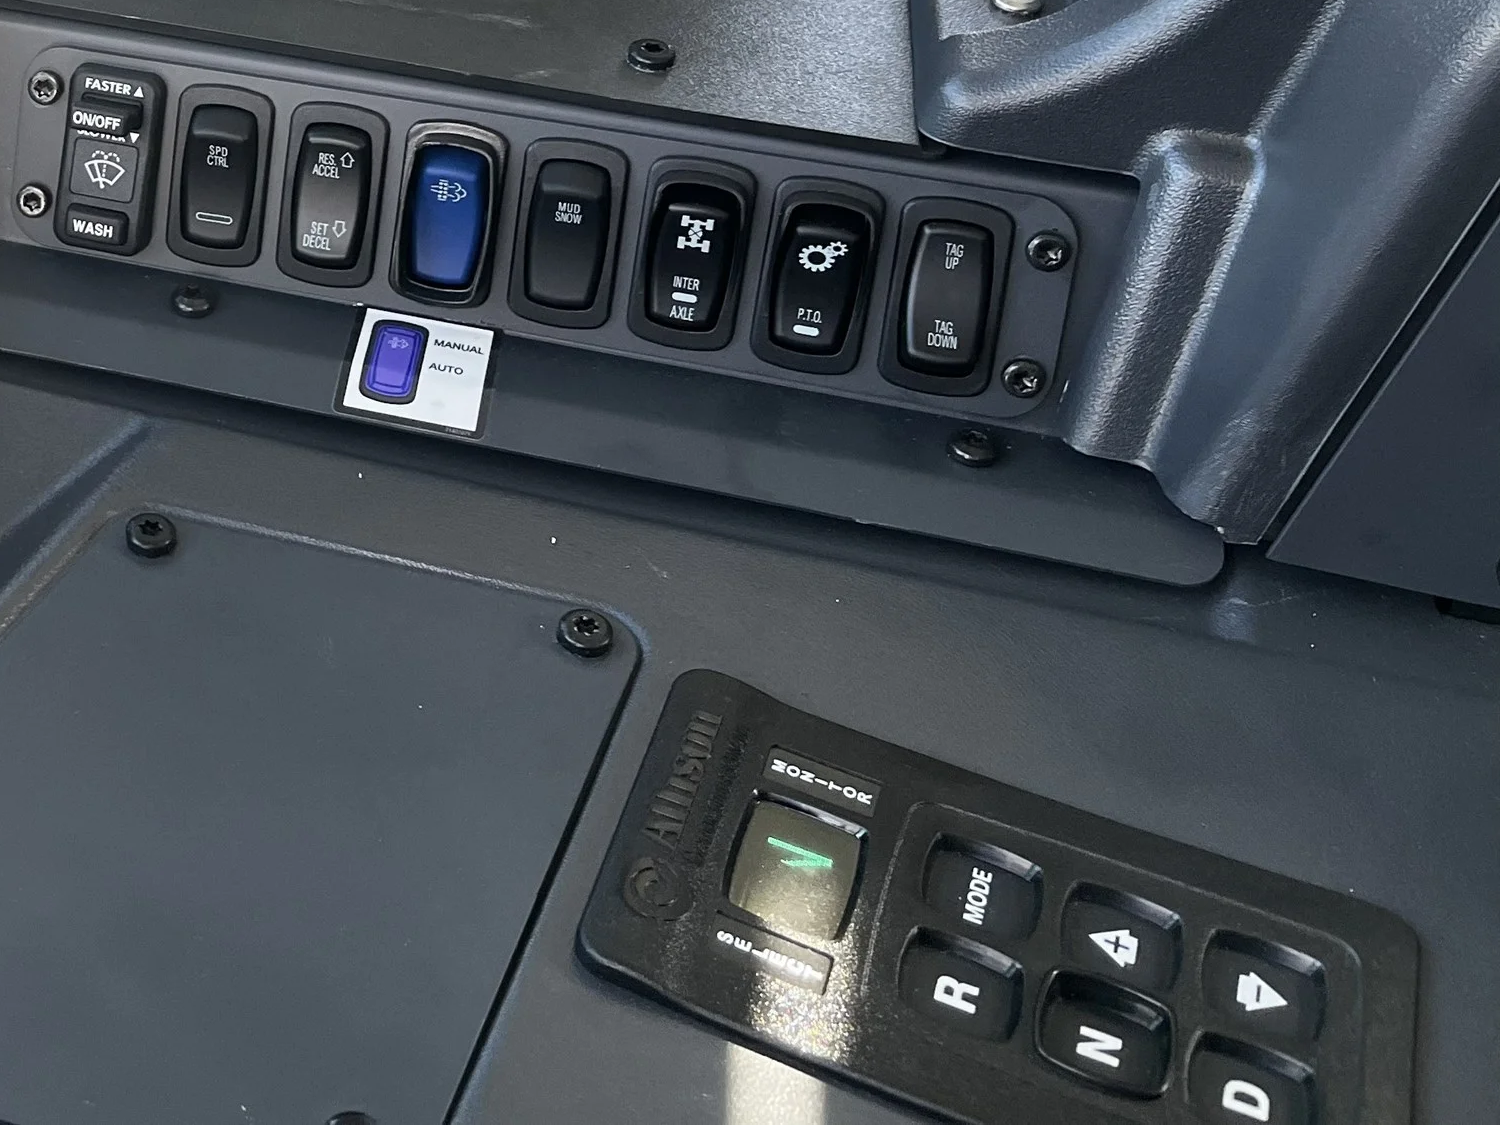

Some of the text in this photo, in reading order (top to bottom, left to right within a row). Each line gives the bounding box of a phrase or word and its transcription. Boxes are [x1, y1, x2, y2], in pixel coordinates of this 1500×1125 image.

[84, 77, 132, 96] FASTER
[72, 111, 121, 131] ON/OFF
[208, 145, 229, 157] SPD
[318, 152, 337, 166] RES.
[206, 155, 229, 168] CTRL
[312, 163, 340, 179] ACCEL
[557, 201, 581, 214] MUD
[554, 211, 583, 225] SNOW
[72, 218, 114, 239] WASH
[310, 221, 329, 236] SET
[302, 233, 331, 251] DECEL
[945, 242, 965, 258] TAG
[944, 256, 959, 270] UP
[672, 275, 700, 291] INTER
[669, 305, 695, 322] AXLE
[796, 307, 823, 324] P.T.O.
[934, 319, 954, 335] TAG
[433, 338, 485, 355] MANUAL
[927, 332, 958, 350] DOWN
[428, 362, 464, 376] AUTO
[770, 757, 873, 806] MONITOR
[962, 866, 993, 926] MODE
[716, 929, 825, 980] SELECT
[933, 974, 981, 1015] R
[1075, 1025, 1123, 1068] N
[1221, 1078, 1271, 1123] D
